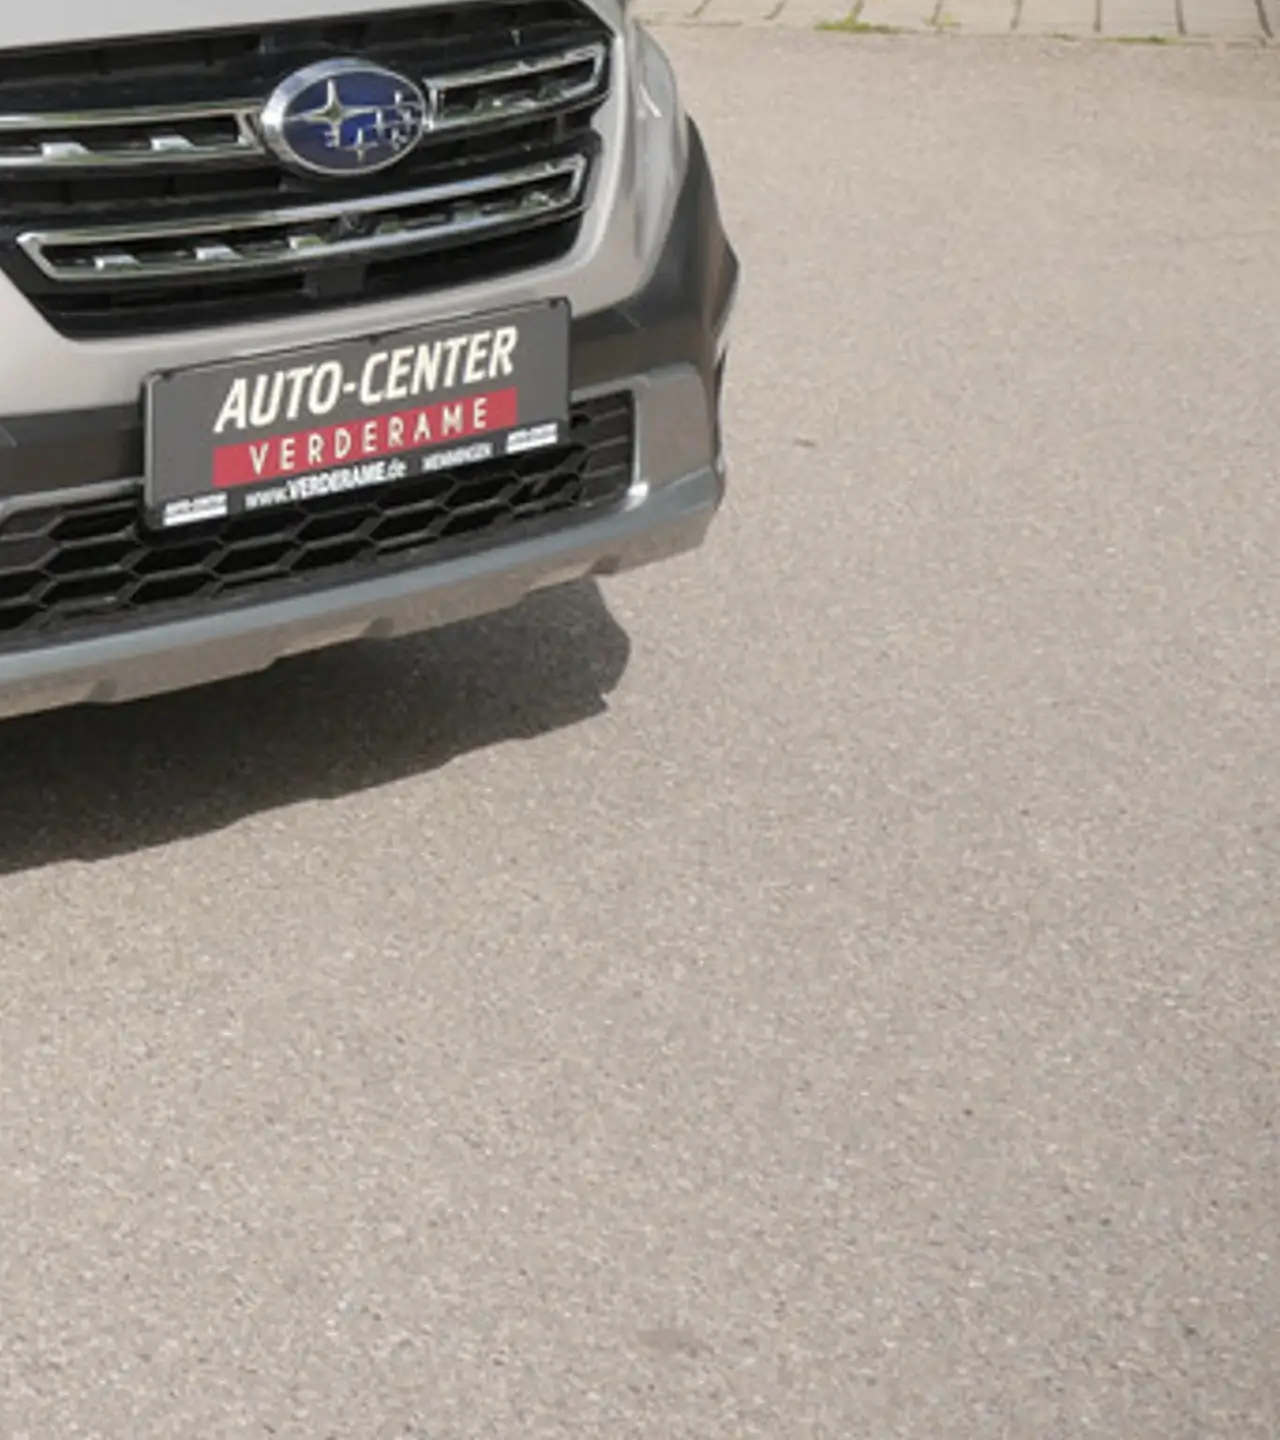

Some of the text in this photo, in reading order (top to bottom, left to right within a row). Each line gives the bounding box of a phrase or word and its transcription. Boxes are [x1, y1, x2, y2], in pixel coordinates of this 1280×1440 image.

[214, 327, 518, 433] AUTO-CENTER
[249, 398, 489, 476] VERDERAME
[245, 459, 407, 509] www.VERDERAME.de
